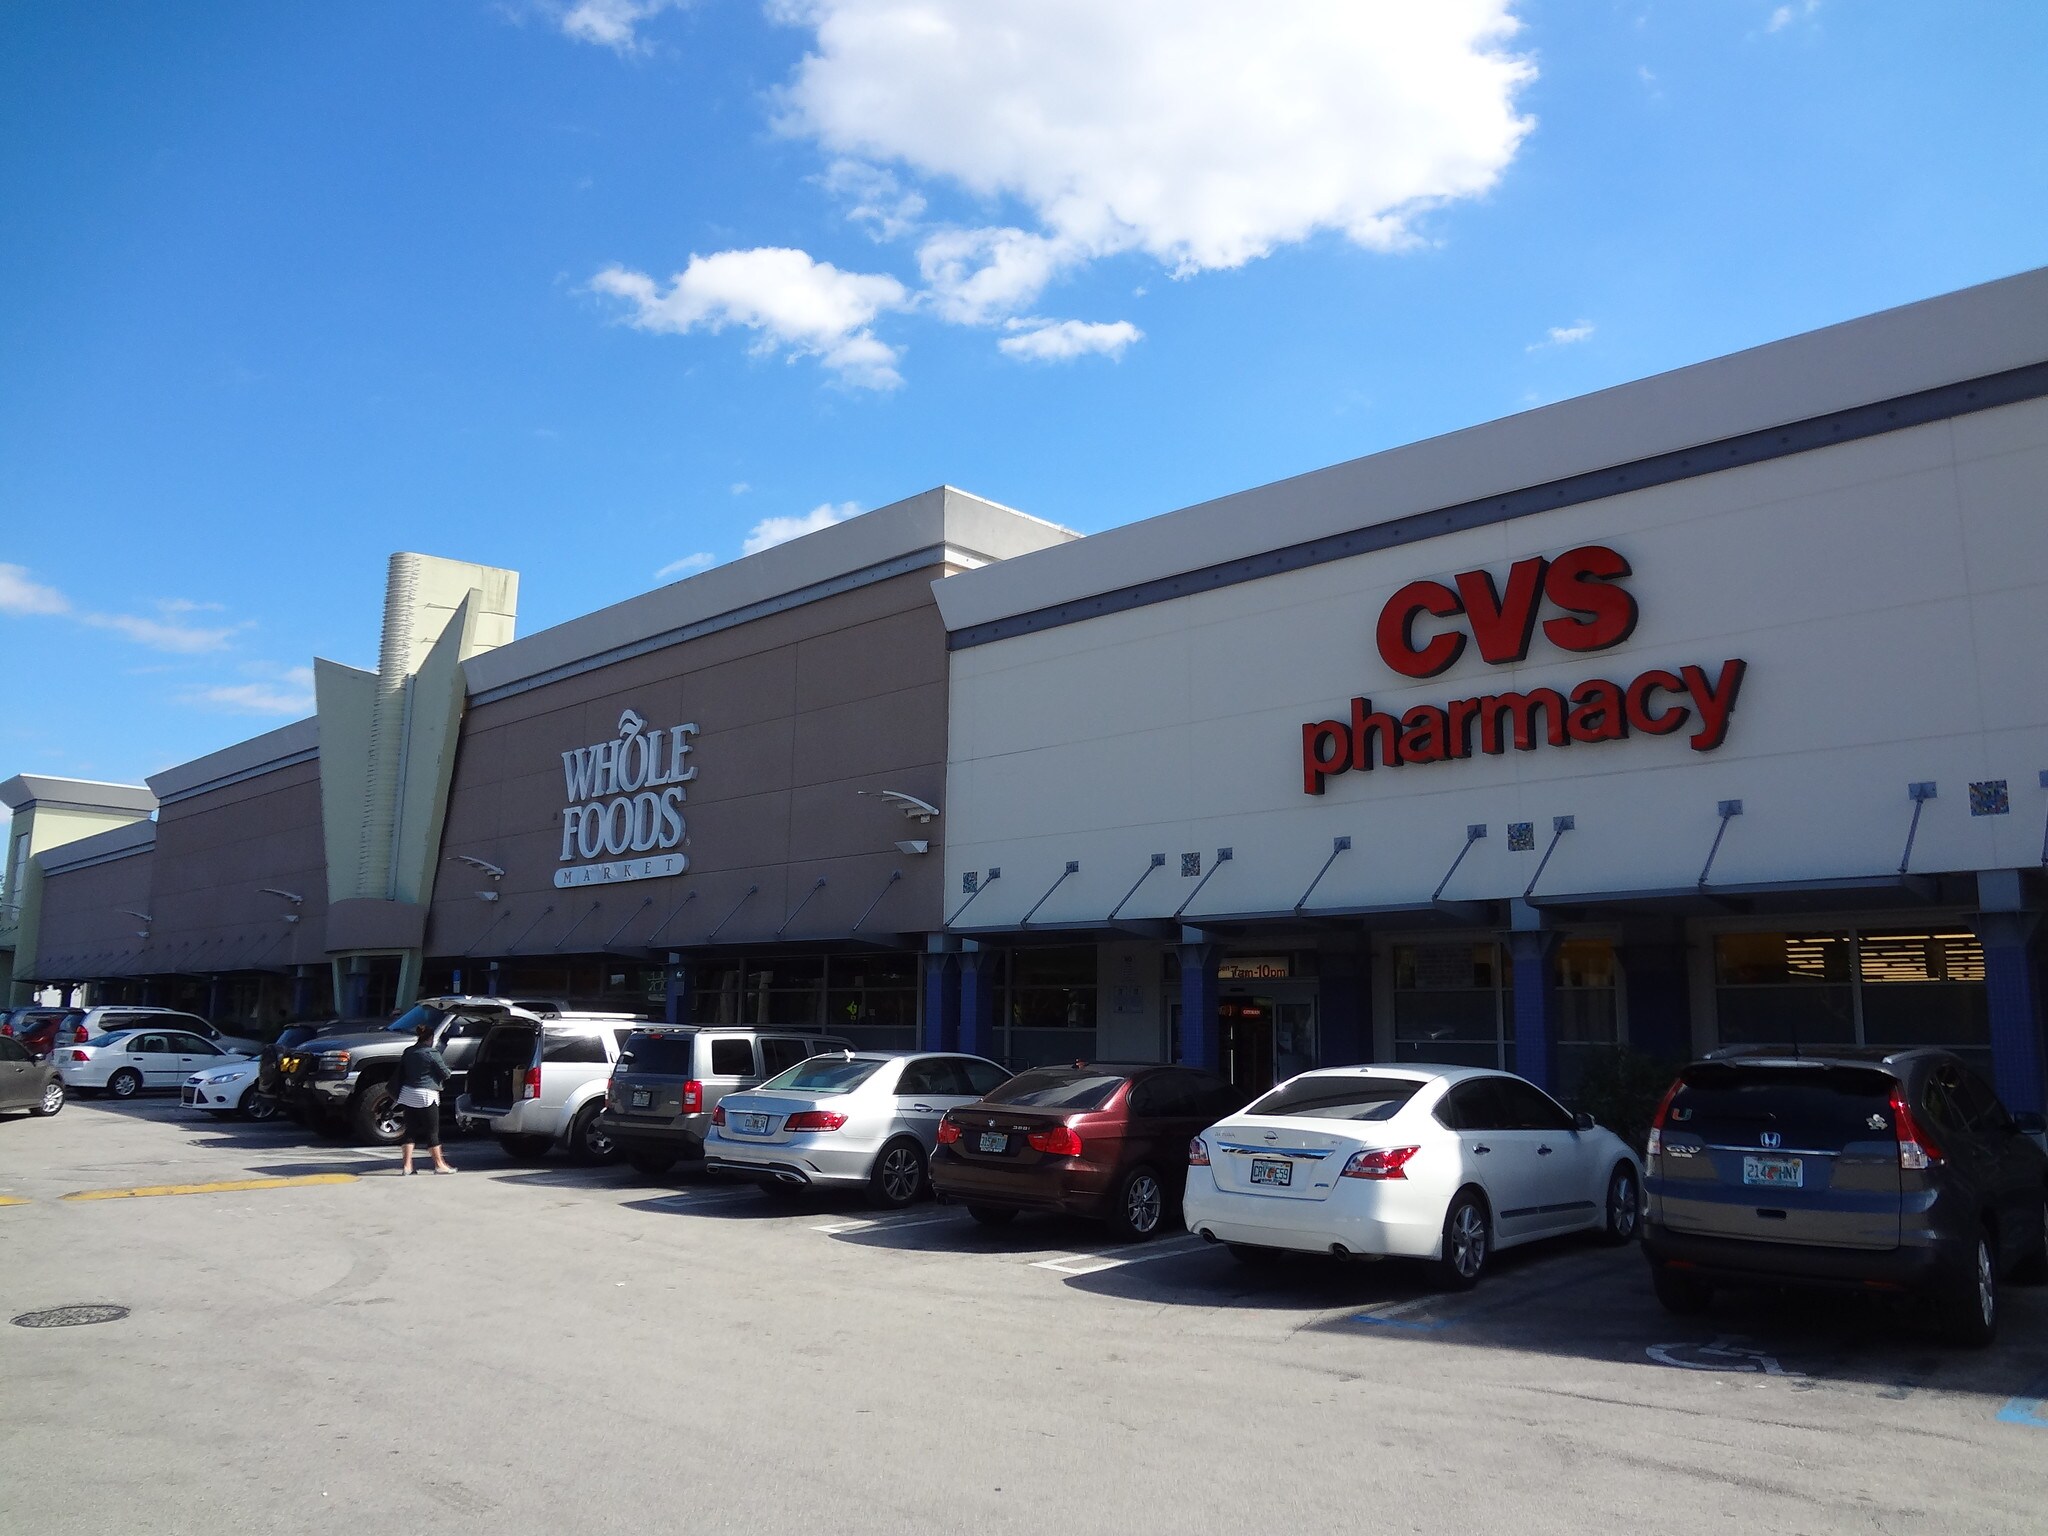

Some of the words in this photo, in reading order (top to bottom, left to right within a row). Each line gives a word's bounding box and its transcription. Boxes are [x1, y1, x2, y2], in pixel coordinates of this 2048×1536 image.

[1376, 545, 1639, 678] CVS
[561, 712, 699, 803] WHOLE
[1302, 658, 1747, 795] pharmacy
[559, 786, 687, 861] FOODS
[563, 859, 673, 884] MARKET
[1778, 1165, 1799, 1180] HNY
